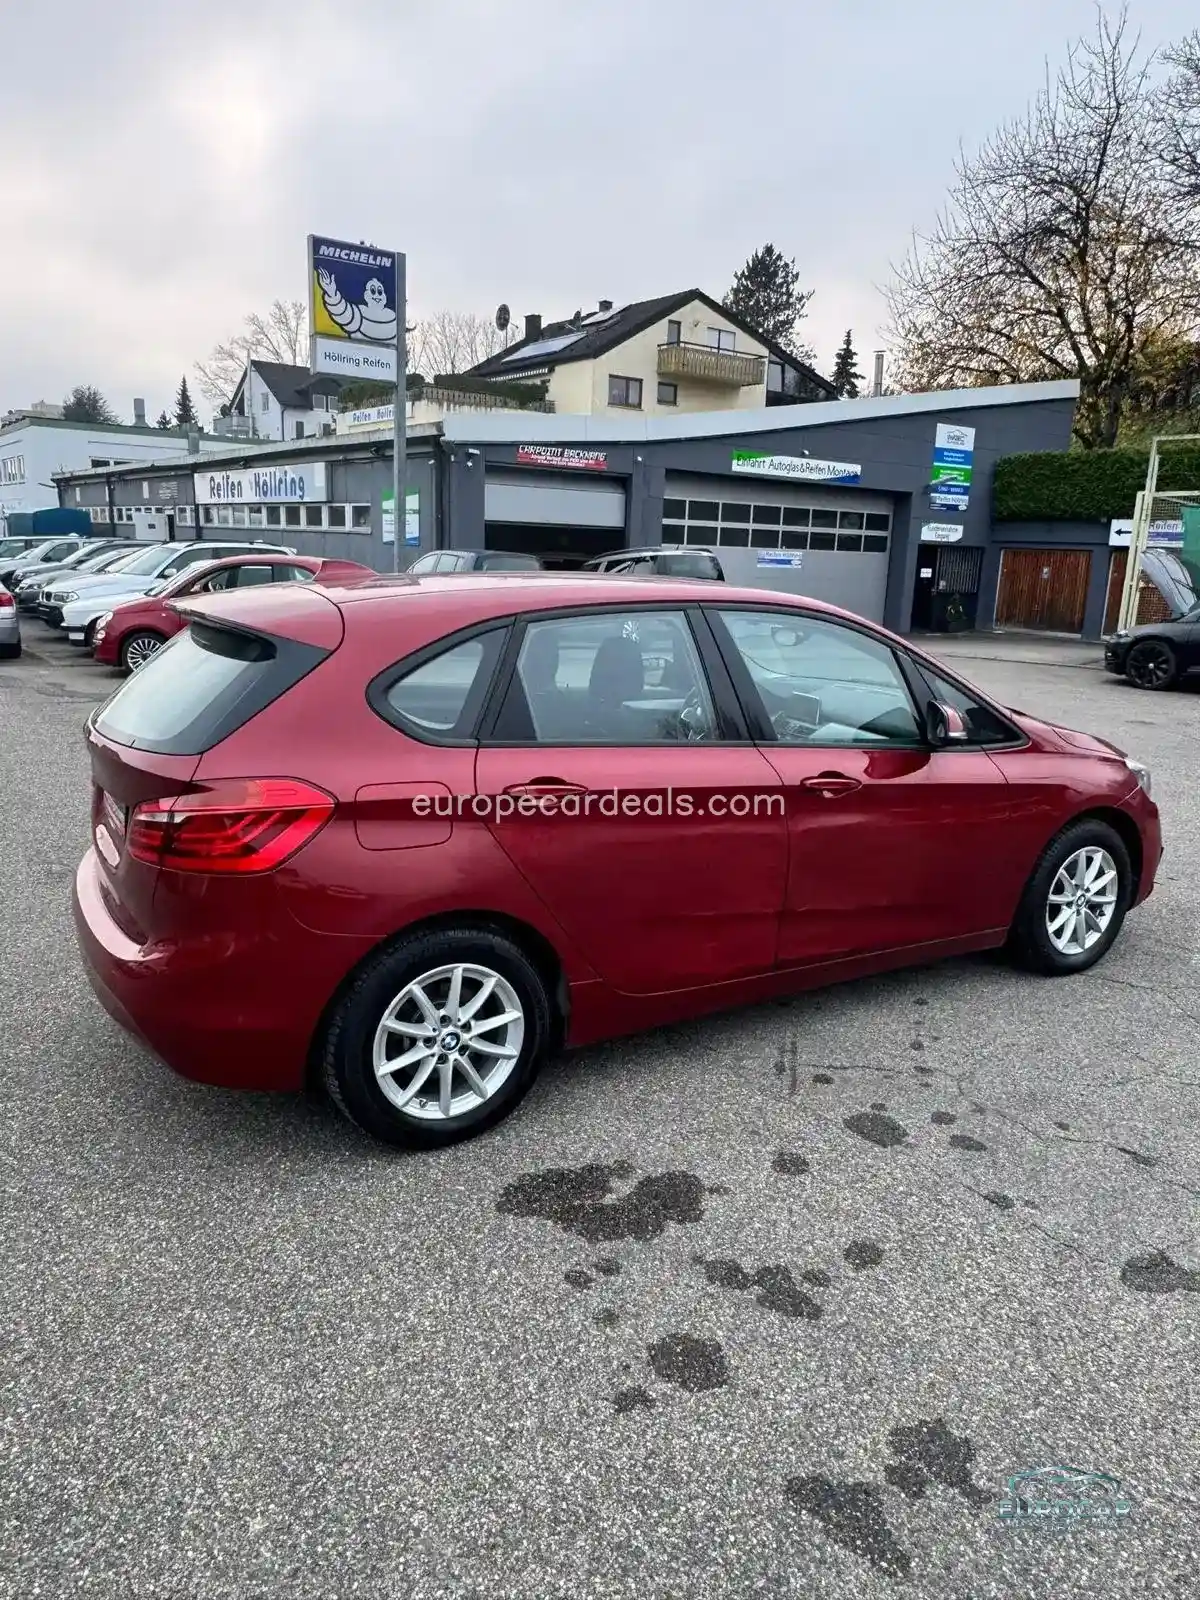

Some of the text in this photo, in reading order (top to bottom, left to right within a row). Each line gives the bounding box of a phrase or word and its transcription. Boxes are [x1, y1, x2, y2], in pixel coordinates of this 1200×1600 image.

[319, 245, 393, 268] MICHELIN
[324, 351, 391, 369] Höllring Reifen
[209, 475, 243, 499] Reifen
[253, 470, 306, 500] Höllring
